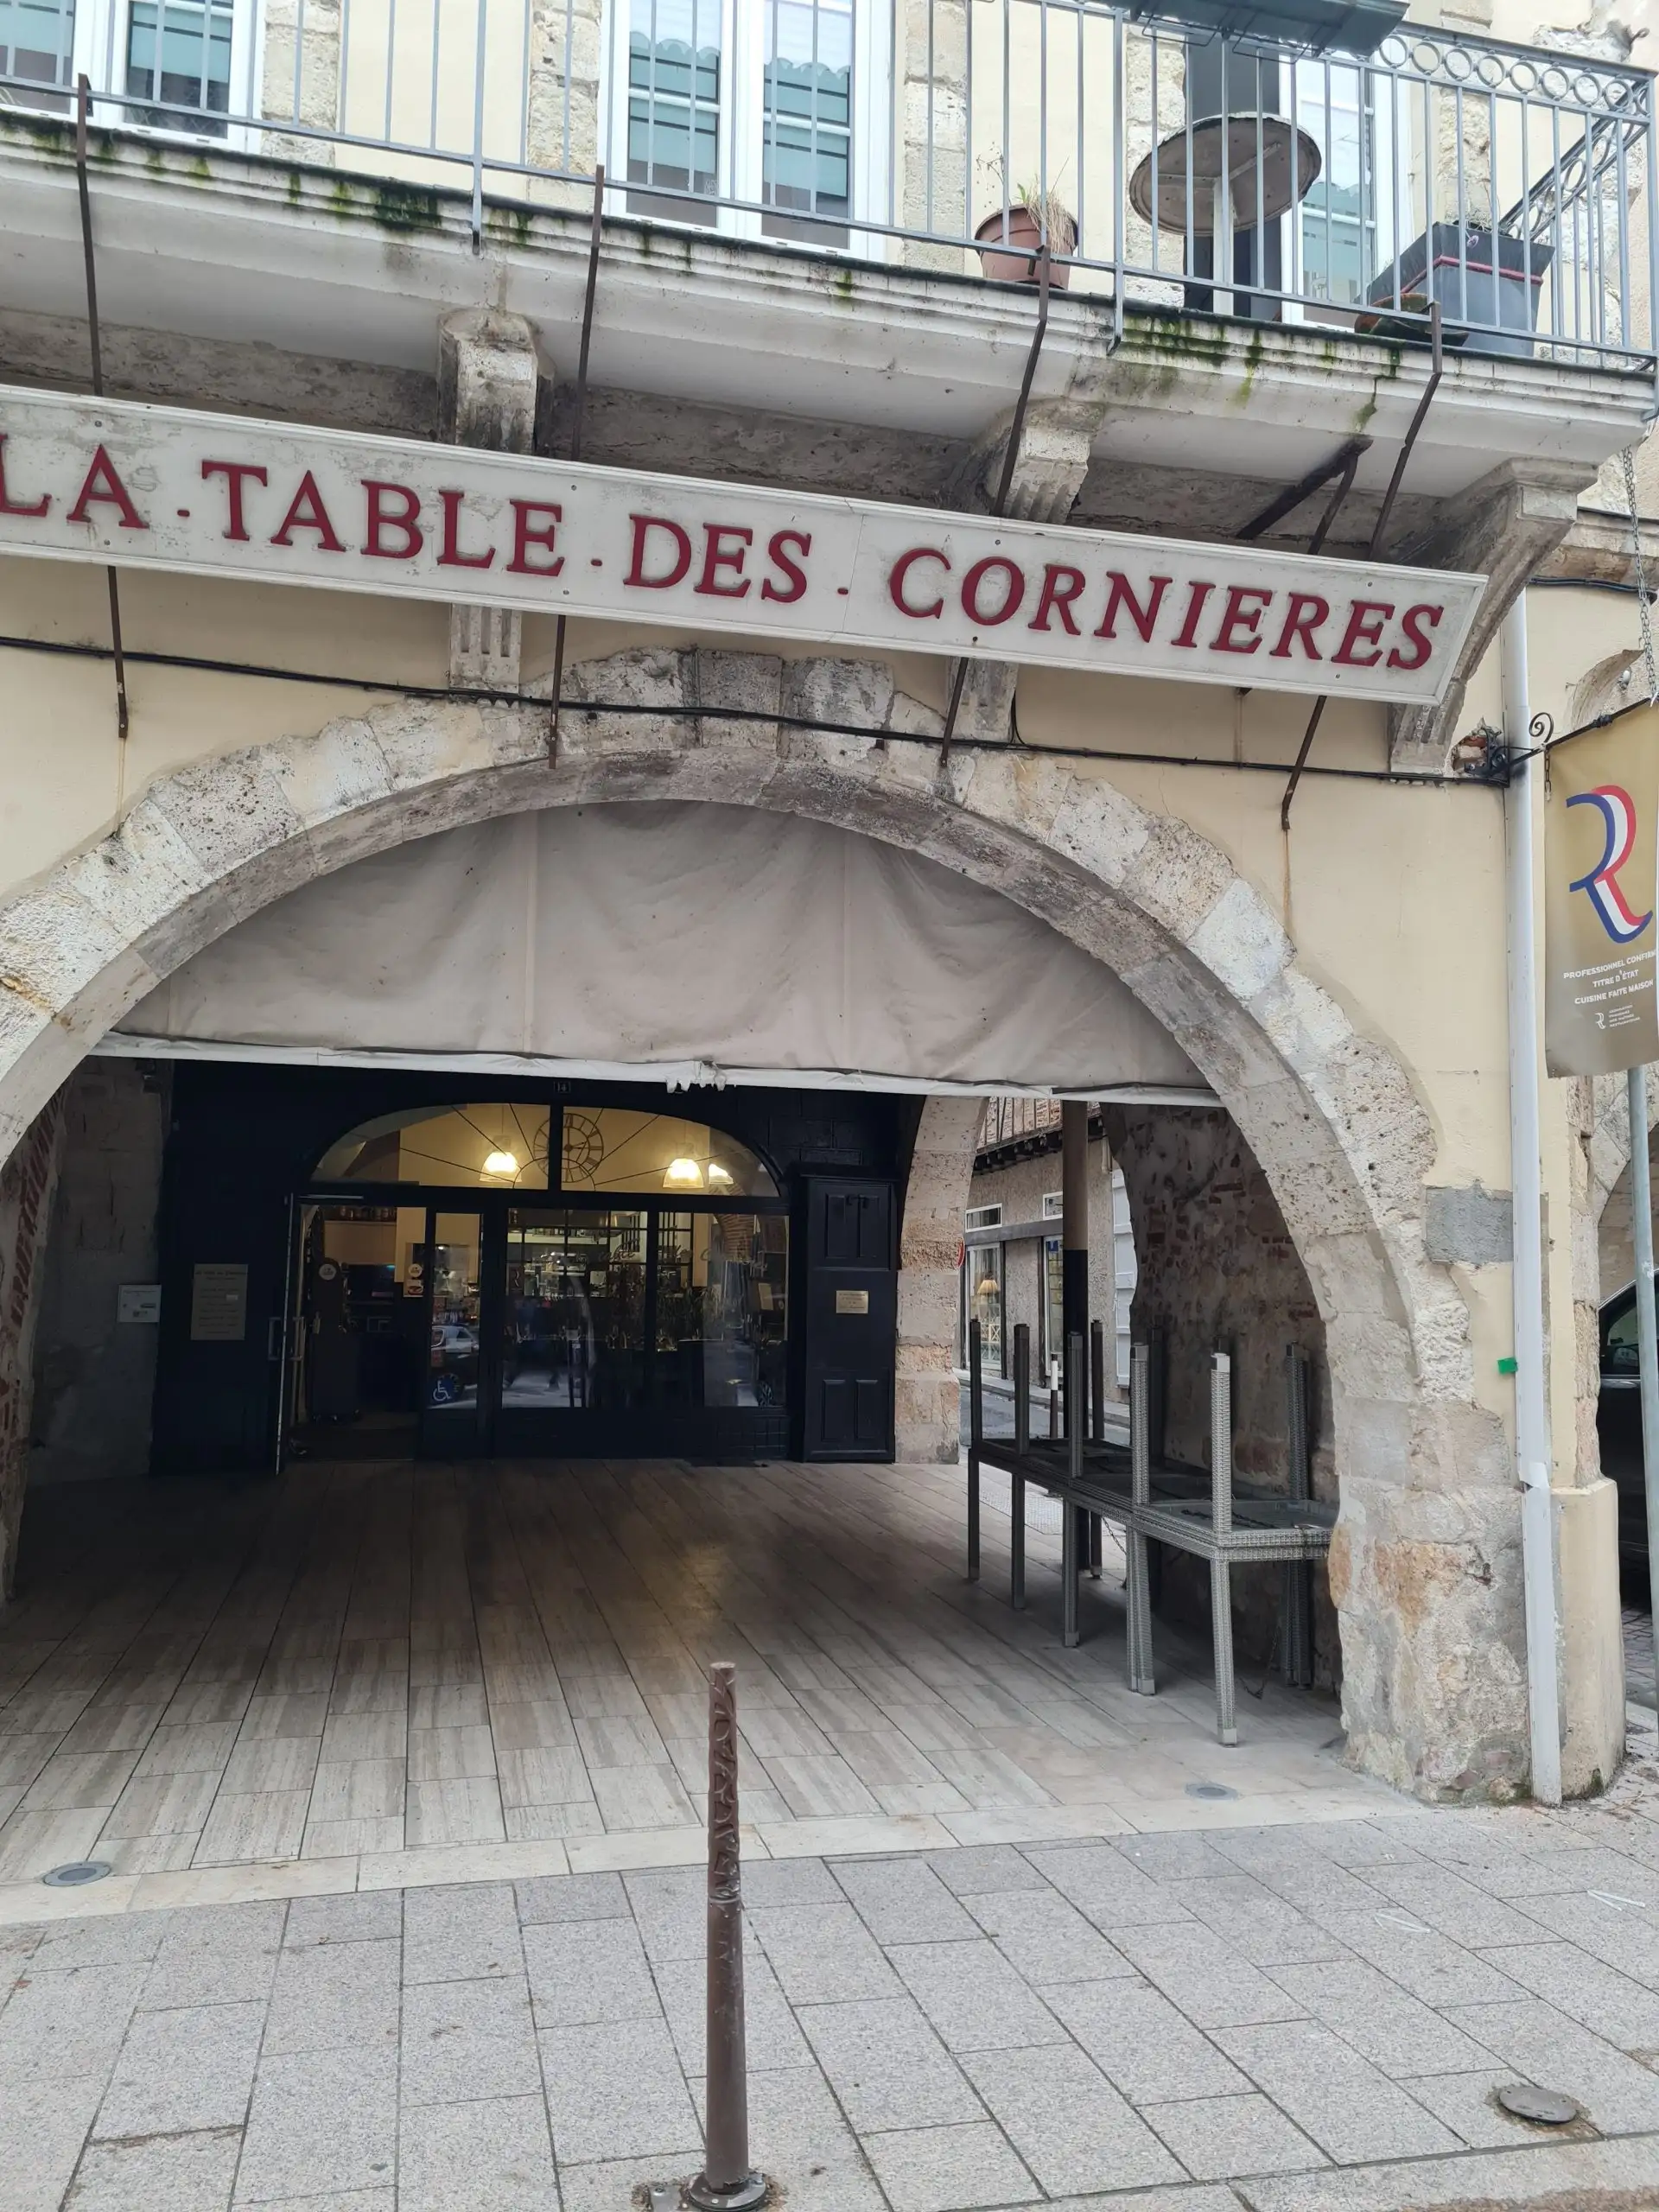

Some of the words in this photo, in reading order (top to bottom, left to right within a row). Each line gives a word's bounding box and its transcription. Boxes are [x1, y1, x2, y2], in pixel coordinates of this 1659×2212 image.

[0, 433, 150, 530] LA
[201, 460, 565, 577] TABLE
[624, 513, 812, 604] DES
[889, 547, 1444, 671] CORNIERES
[1563, 959, 1625, 979] PROFESSIONNEL
[1574, 992, 1607, 1004] CUISINE
[1608, 987, 1628, 998] FAITE
[1628, 978, 1654, 993] MAISON
[1592, 976, 1614, 988] TITRE
